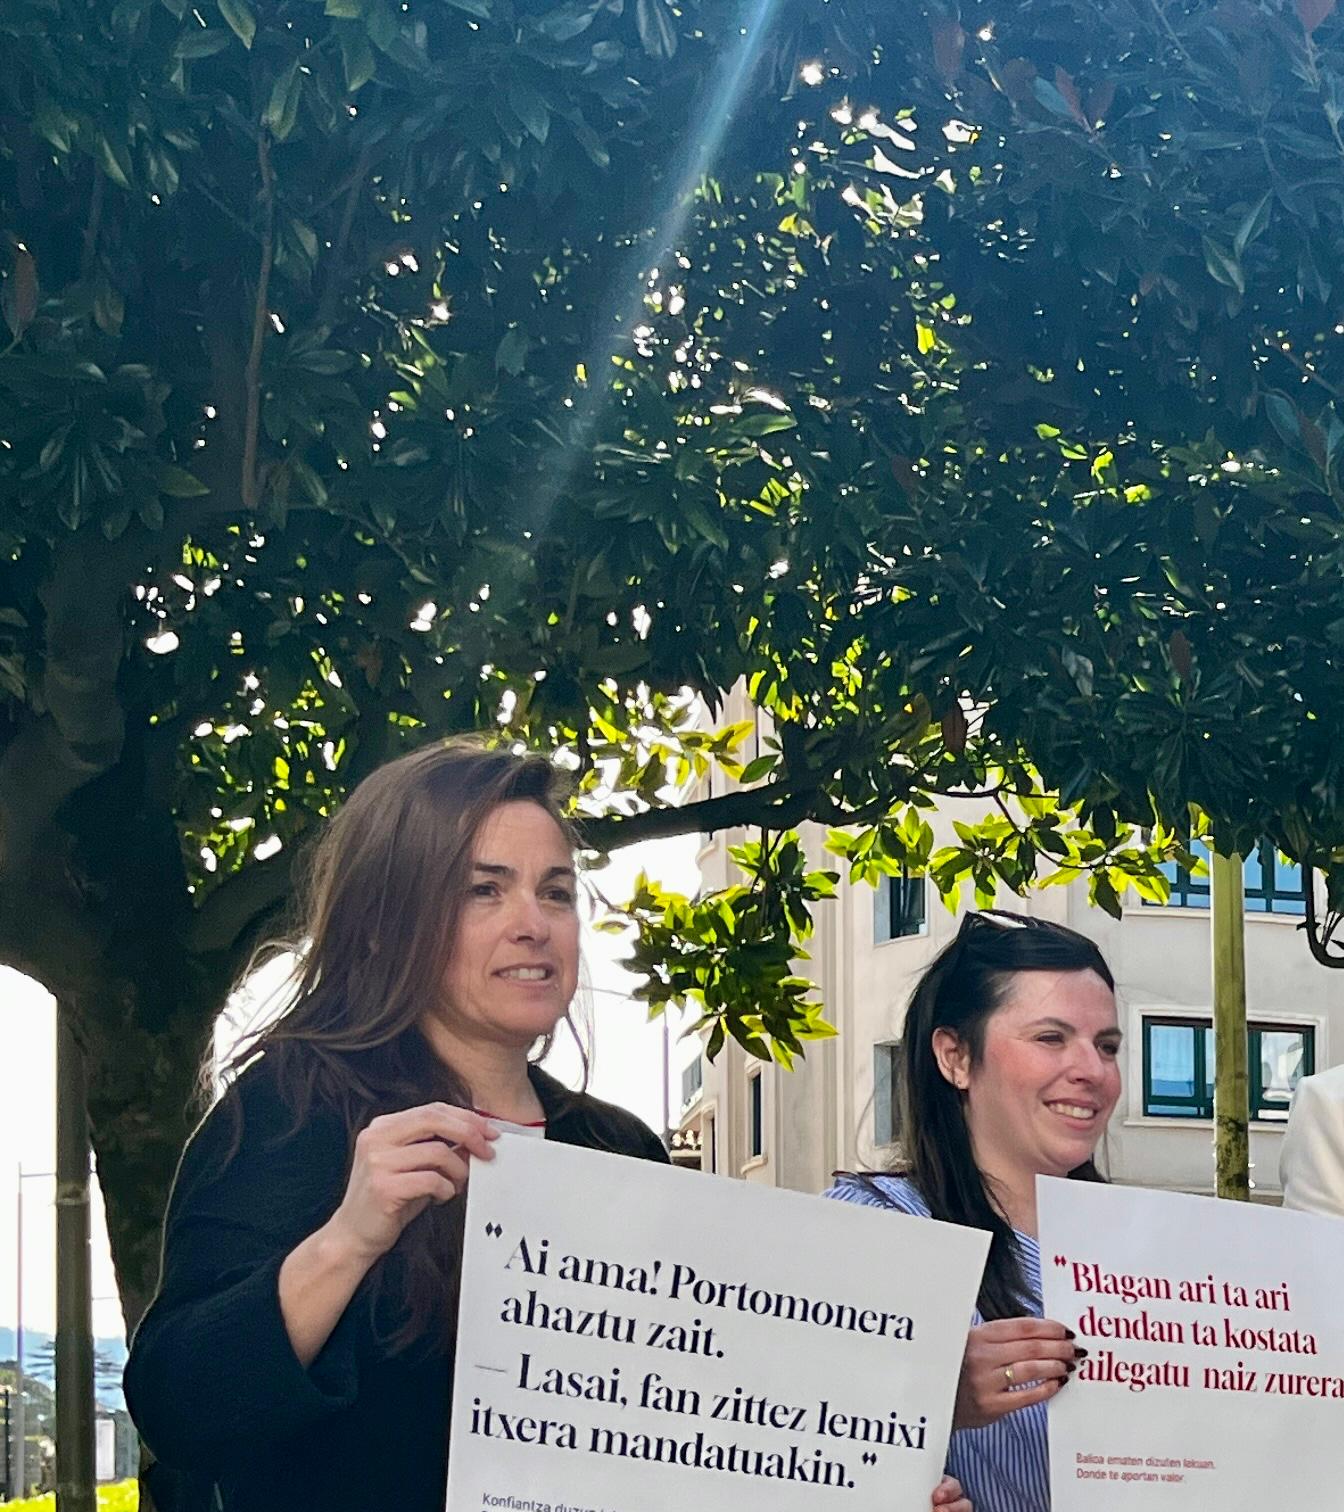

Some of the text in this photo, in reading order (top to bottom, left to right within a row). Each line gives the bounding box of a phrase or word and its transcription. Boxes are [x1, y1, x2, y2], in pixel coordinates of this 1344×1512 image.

[559, 1256, 661, 1295] ama!
[669, 1264, 913, 1340] Portomonera
[1180, 1275, 1216, 1304] ari
[1223, 1283, 1248, 1307] ta
[1256, 1283, 1289, 1311] ari
[501, 1291, 724, 1358] ahaztu zait.
[1078, 1306, 1317, 1355] dendan ta kostata
[1078, 1353, 1189, 1391] ailegatu
[1204, 1361, 1256, 1391] naiz
[471, 1398, 577, 1449] itxera
[518, 1354, 926, 1449] Lasai, fan zittez lemixi
[483, 1493, 551, 1512] Konfiantza
